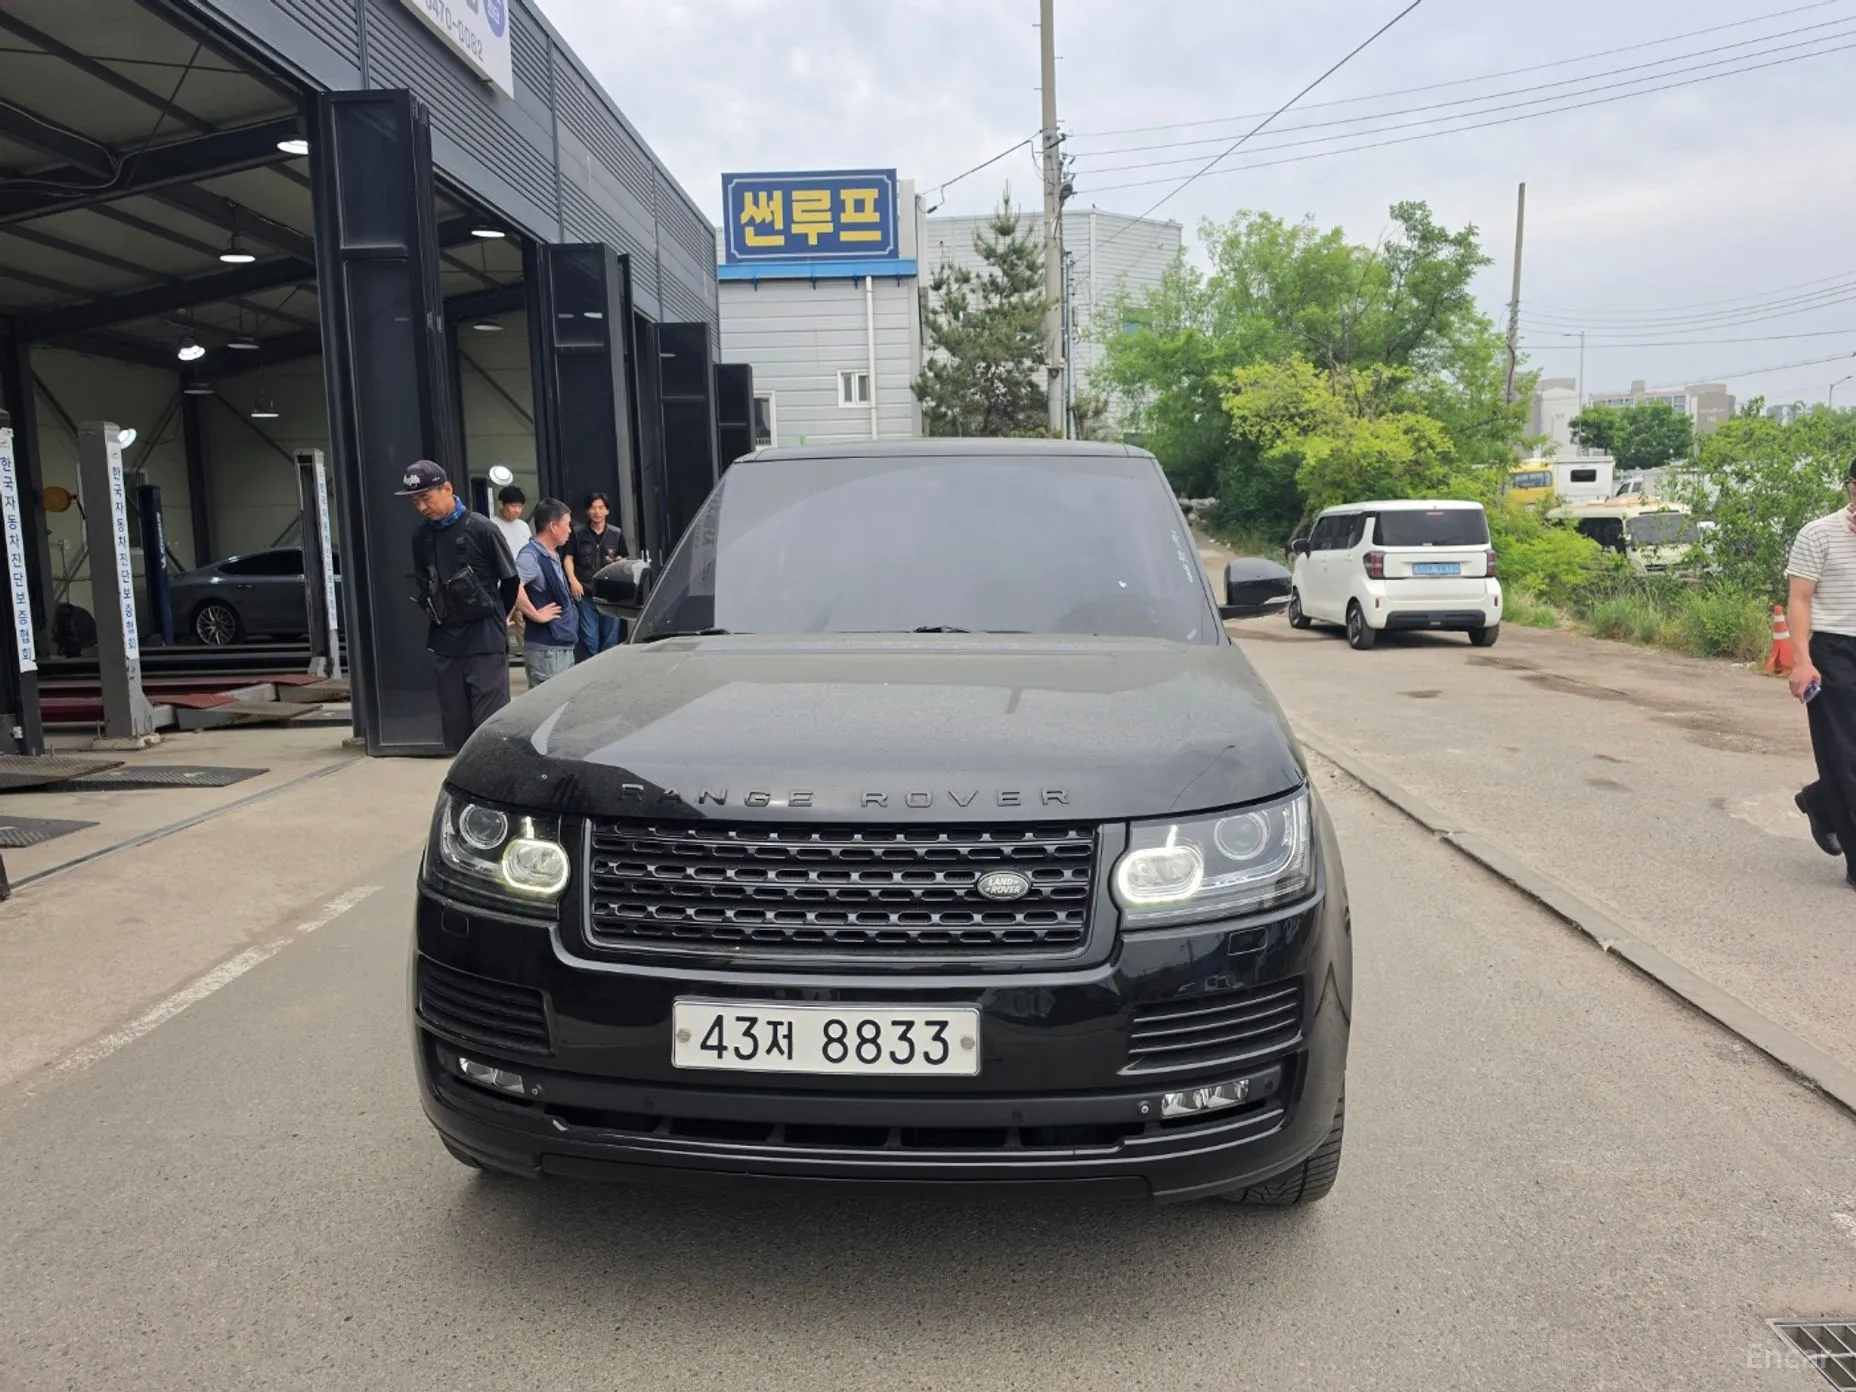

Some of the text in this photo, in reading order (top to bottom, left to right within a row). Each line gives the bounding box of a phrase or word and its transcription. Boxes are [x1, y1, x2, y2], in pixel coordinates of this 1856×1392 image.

[740, 188, 882, 247] 썬루프
[620, 783, 1070, 809] RANGE ROVER
[988, 877, 1013, 886] LAND
[990, 885, 1021, 894] ROVER
[700, 1014, 950, 1066] 43저 8833
